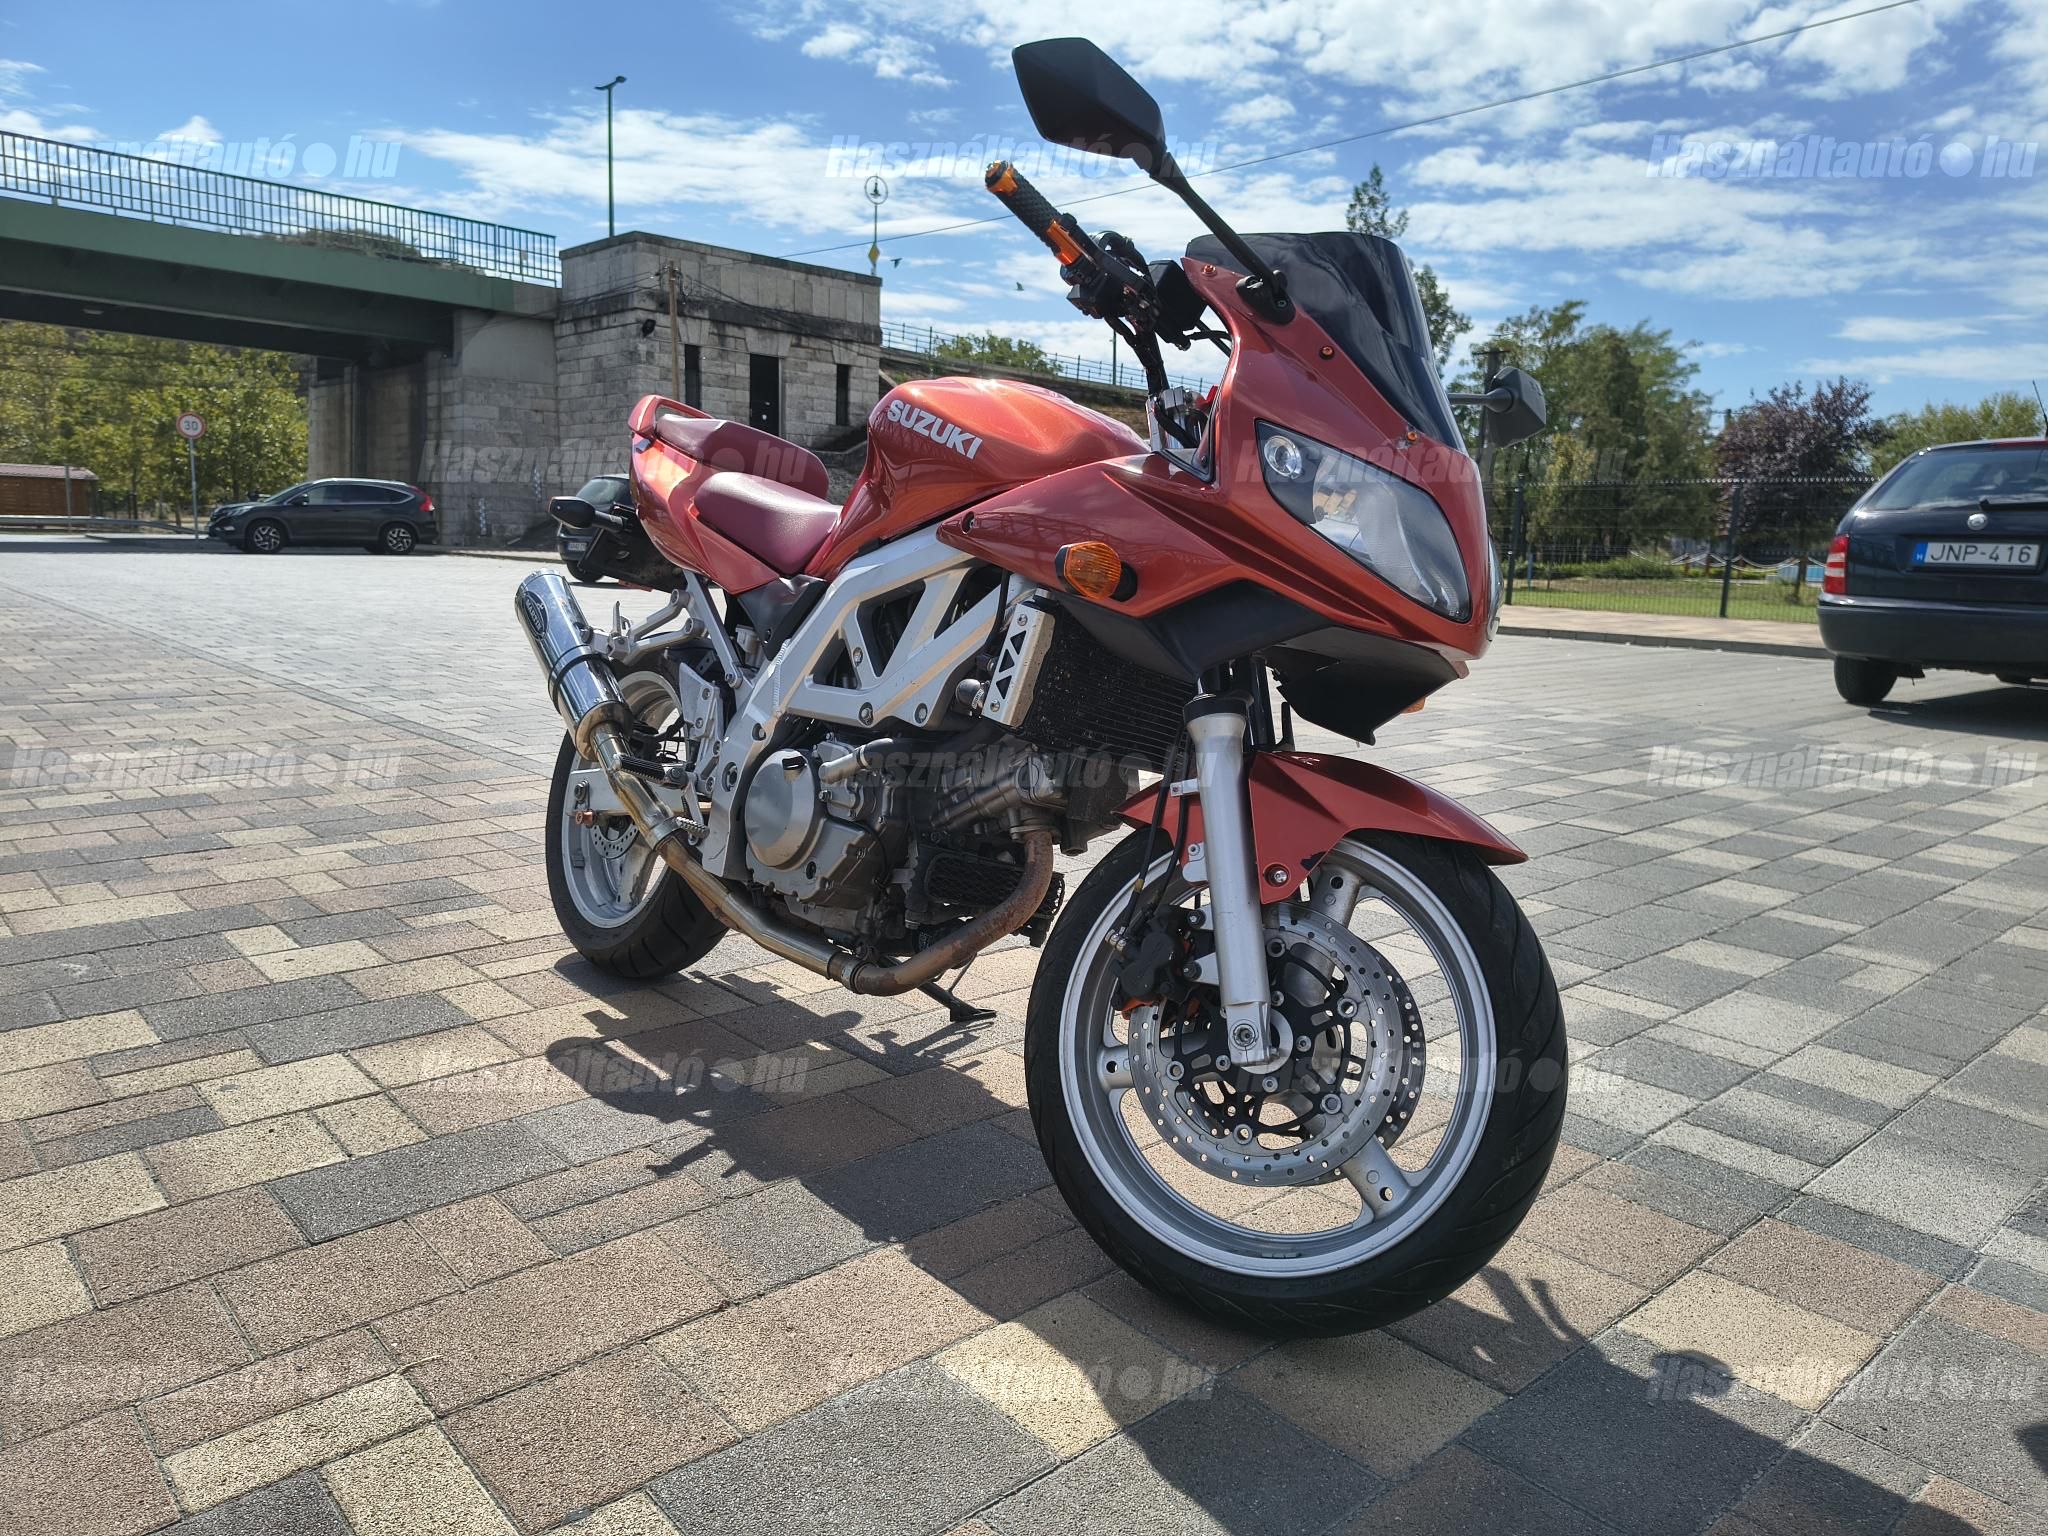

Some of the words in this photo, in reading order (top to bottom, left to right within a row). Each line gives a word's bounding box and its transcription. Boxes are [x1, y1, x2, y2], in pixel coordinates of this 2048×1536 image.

[183, 420, 199, 431] 30
[887, 400, 983, 459] SUZUKI
[1930, 544, 2032, 563] JNP-416
